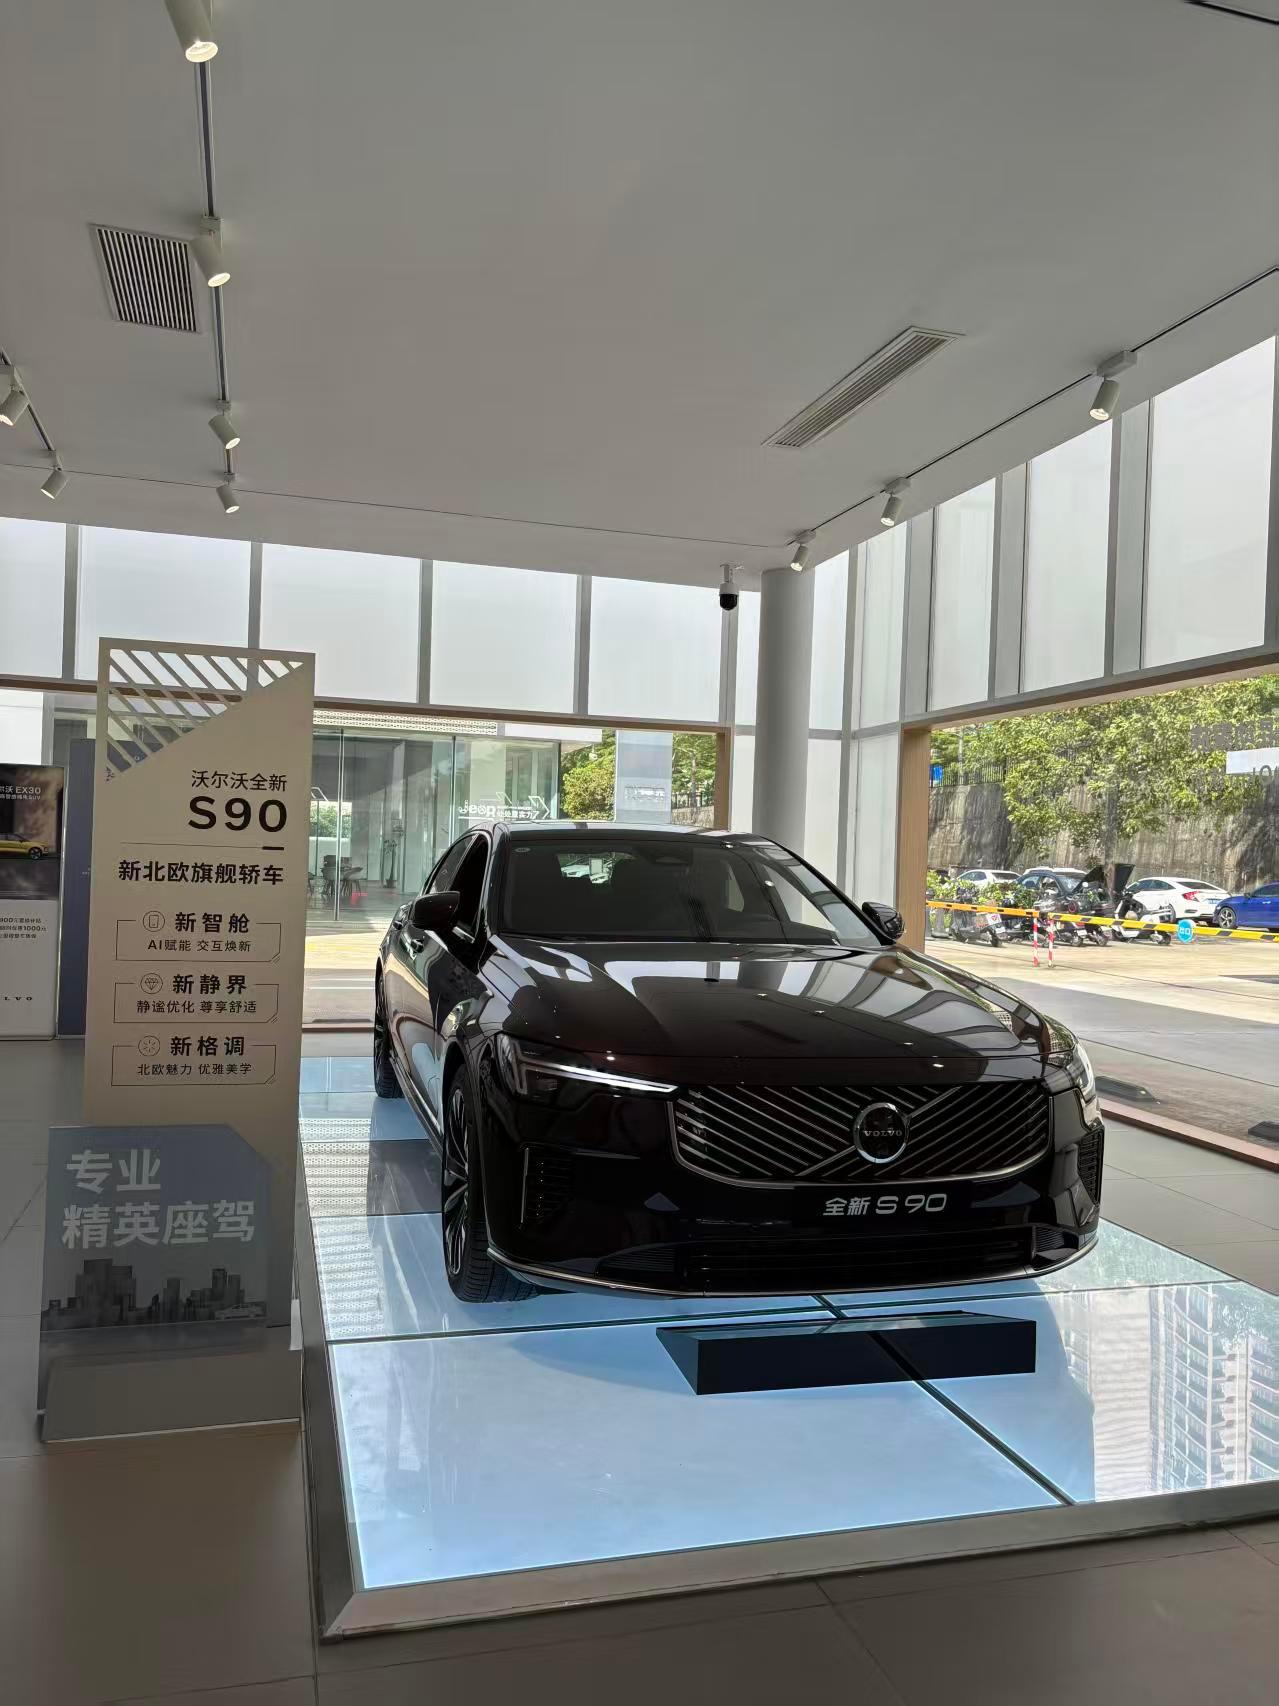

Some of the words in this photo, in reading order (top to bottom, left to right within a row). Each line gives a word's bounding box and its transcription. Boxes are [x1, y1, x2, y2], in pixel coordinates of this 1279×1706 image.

[15, 786, 42, 795] EX30
[191, 770, 288, 792] 沃尔沃全新
[188, 796, 288, 833] S90
[118, 860, 284, 886] 新北欧旗舰轿车
[175, 912, 250, 934] 新智舱
[147, 939, 191, 952] AI赋能
[197, 940, 252, 953] 交互焕新
[172, 974, 247, 995] 新静界
[136, 1000, 195, 1014] 静谧优化
[199, 1000, 257, 1014] 尊享舒适
[170, 1036, 245, 1057] 新格调
[137, 1063, 193, 1076] 北欧魅力
[198, 1062, 252, 1075] 优雅美学
[863, 1129, 903, 1138] VOLVO
[66, 1149, 161, 1194] 专业
[822, 1197, 872, 1216] 全新
[61, 1199, 255, 1249] 精英座驾
